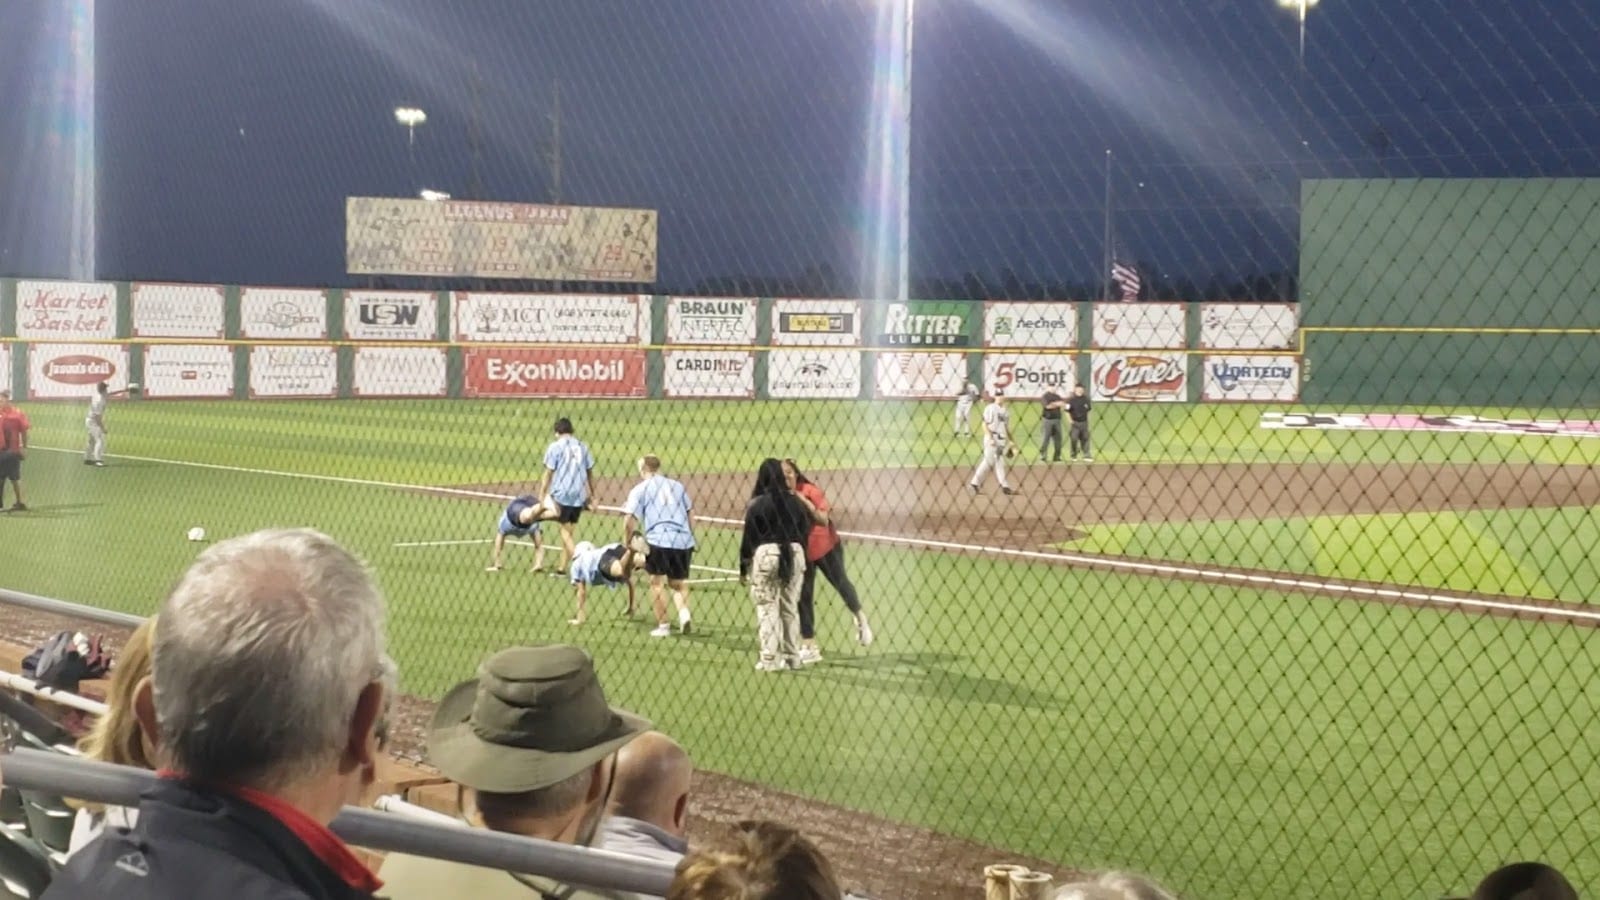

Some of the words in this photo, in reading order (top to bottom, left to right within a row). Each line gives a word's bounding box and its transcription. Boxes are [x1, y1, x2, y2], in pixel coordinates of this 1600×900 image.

[24, 289, 107, 310] Market
[680, 301, 743, 315] BRAUN
[22, 310, 107, 332] Basket
[360, 304, 420, 325] USW
[501, 307, 546, 324] MCT
[884, 303, 962, 335] RITTER
[889, 335, 956, 344] LUMBER
[487, 358, 624, 387] ExxonMobil
